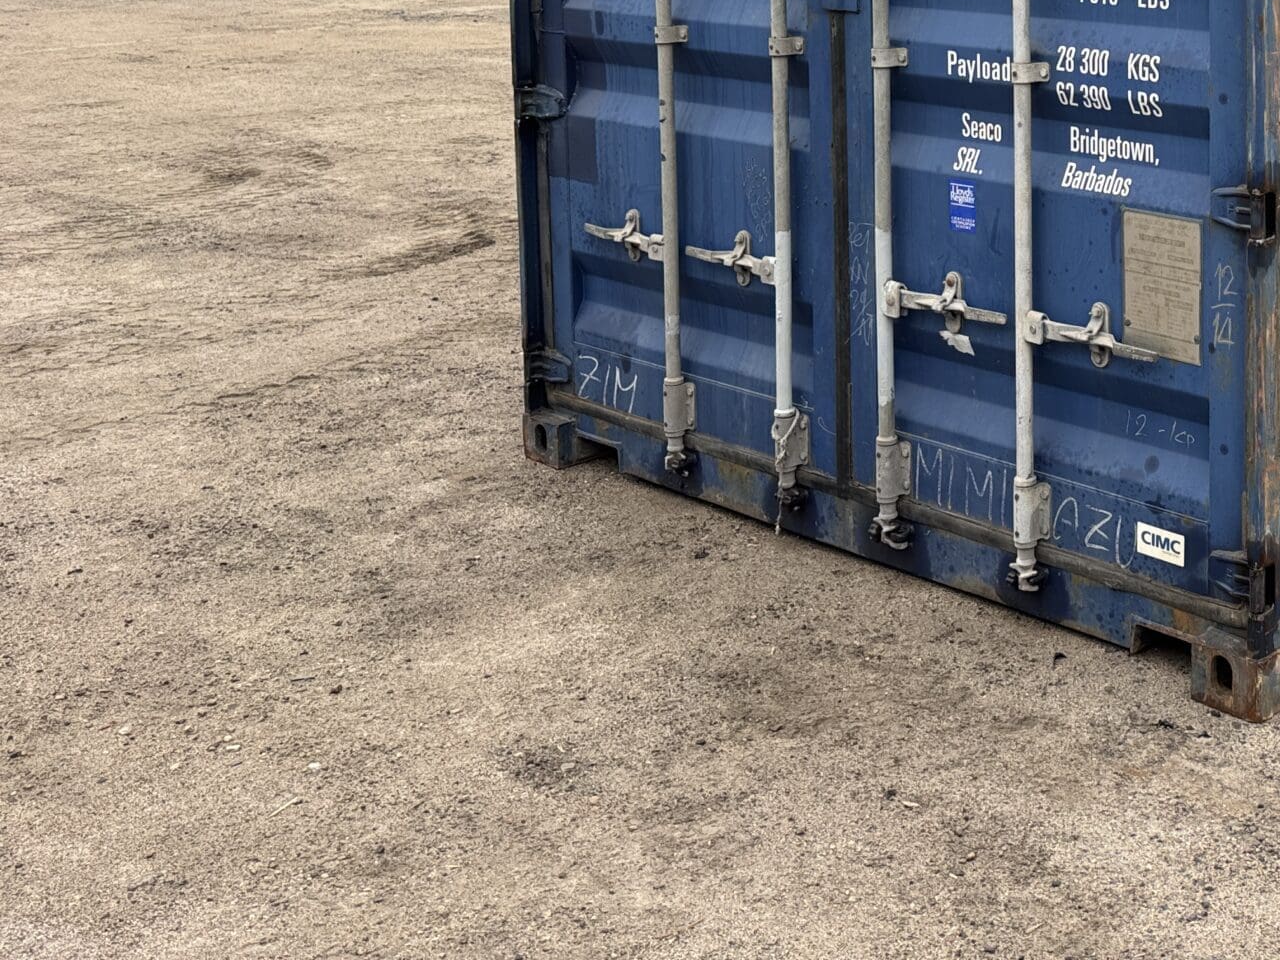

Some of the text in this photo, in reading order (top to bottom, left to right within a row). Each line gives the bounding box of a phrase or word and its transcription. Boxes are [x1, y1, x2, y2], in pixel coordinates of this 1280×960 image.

[947, 50, 1011, 83] Payload
[1127, 53, 1160, 82] KGS
[1128, 90, 1163, 118] LBS
[962, 112, 1002, 142] Seaco
[953, 146, 983, 175] SRL.
[1070, 126, 1160, 166] Bridgetown,
[1061, 162, 1132, 197] Barbados
[1141, 530, 1181, 555] CIMC
